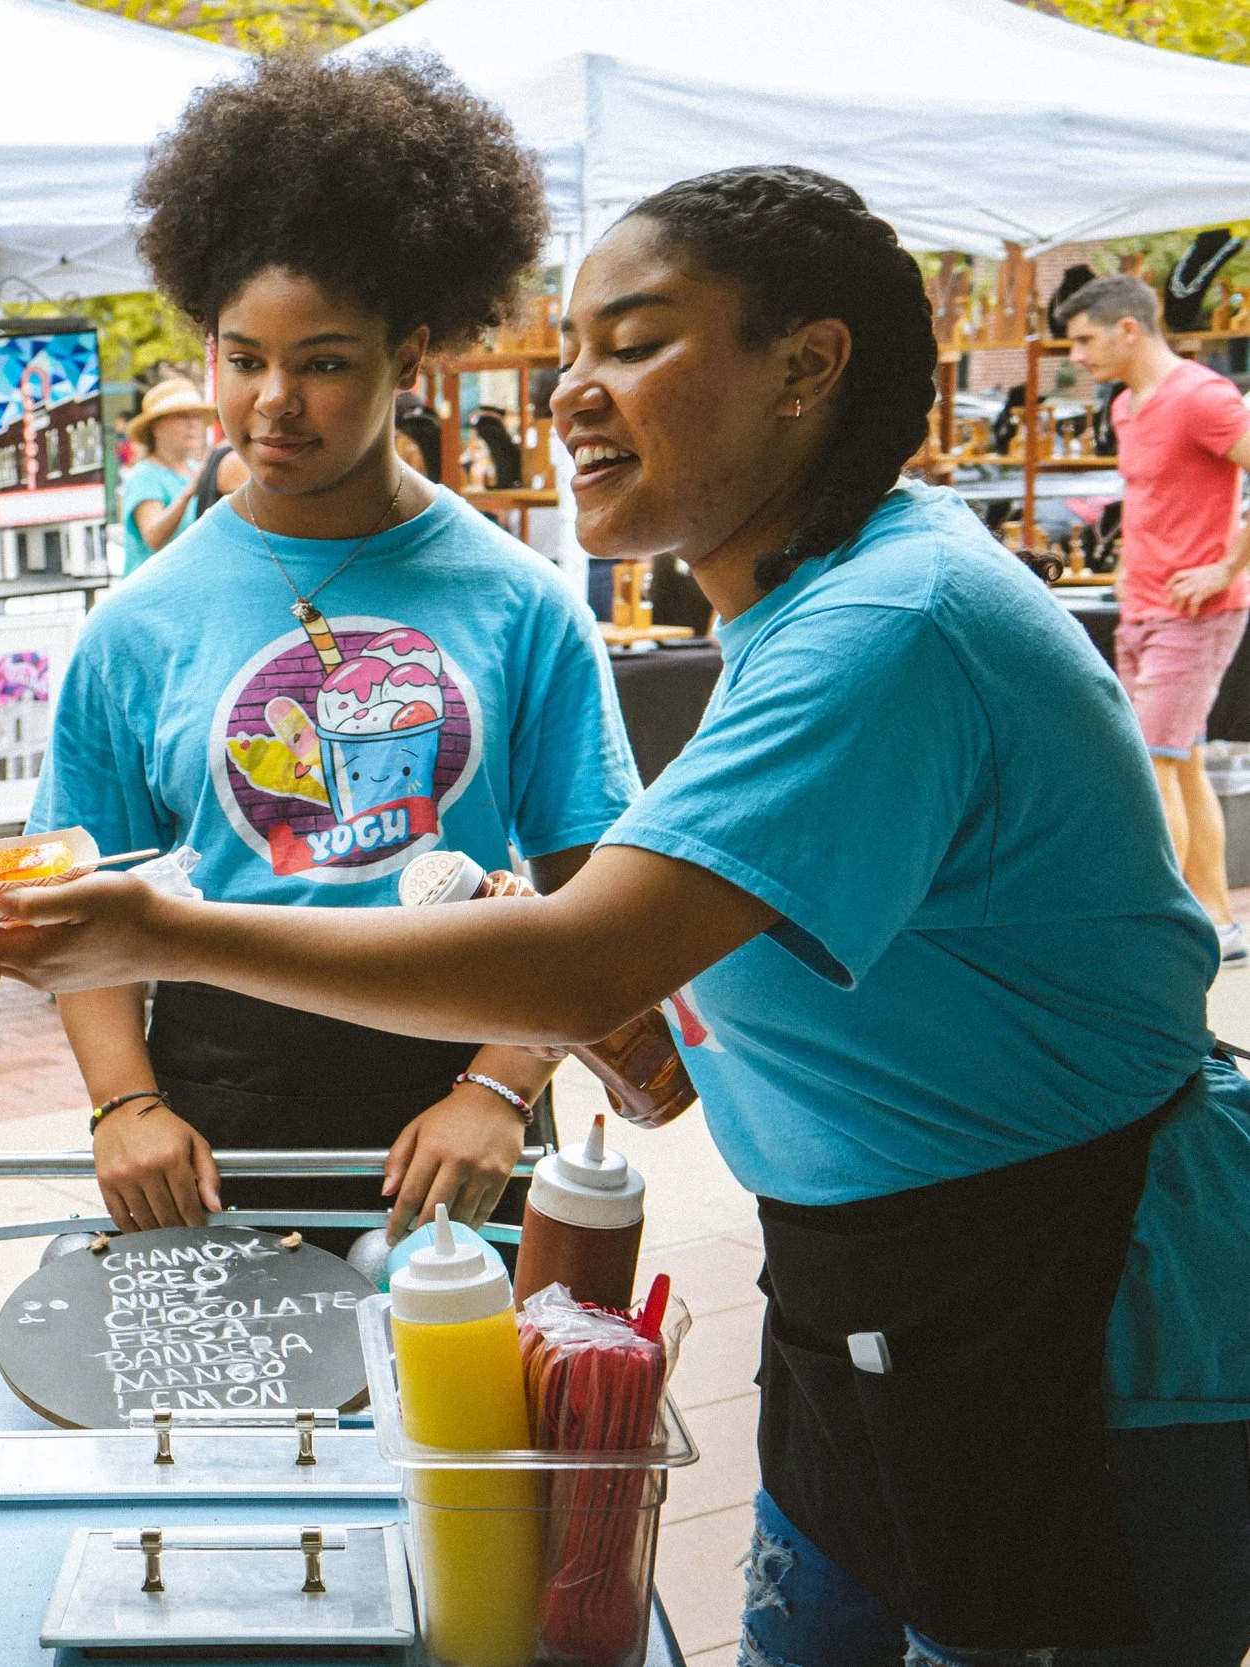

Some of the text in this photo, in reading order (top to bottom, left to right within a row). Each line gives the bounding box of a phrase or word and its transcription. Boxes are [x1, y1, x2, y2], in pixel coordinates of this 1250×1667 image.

[307, 807, 409, 862] YOGU
[102, 1238, 263, 1271] CHAMOY
[109, 1264, 228, 1293] OREO
[104, 1291, 358, 1330] CHOCOLATE
[111, 1287, 225, 1310] NUEZ
[109, 1319, 250, 1349] FRESA
[99, 1333, 313, 1370] BANDERA
[113, 1359, 286, 1392] MANGO
